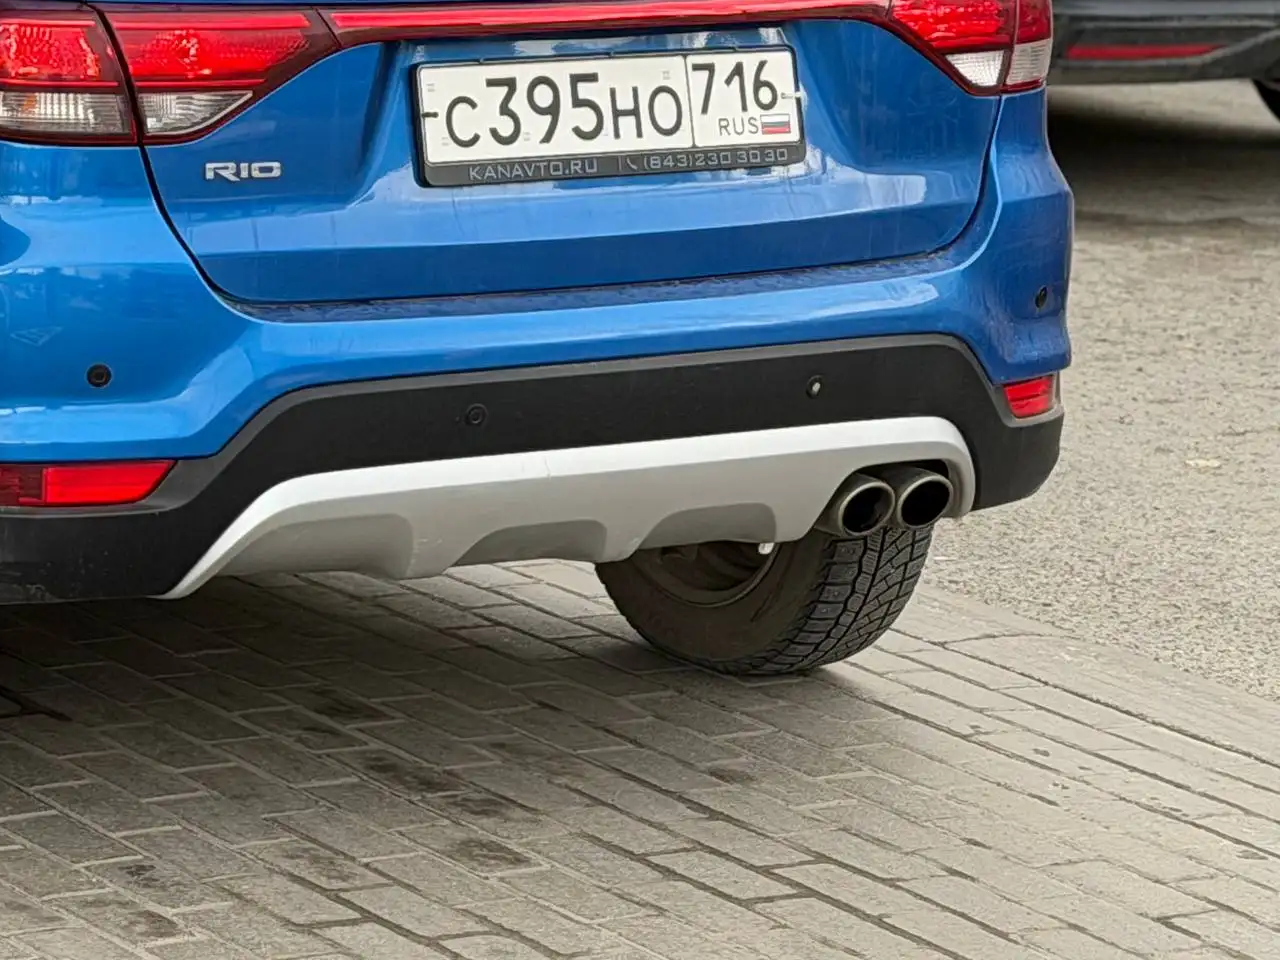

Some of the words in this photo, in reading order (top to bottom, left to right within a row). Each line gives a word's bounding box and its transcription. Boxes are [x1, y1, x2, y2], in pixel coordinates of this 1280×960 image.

[692, 59, 778, 115] 716
[719, 116, 759, 137] RUS
[205, 161, 281, 181] RIO
[468, 158, 599, 181] KANAVTO.RU
